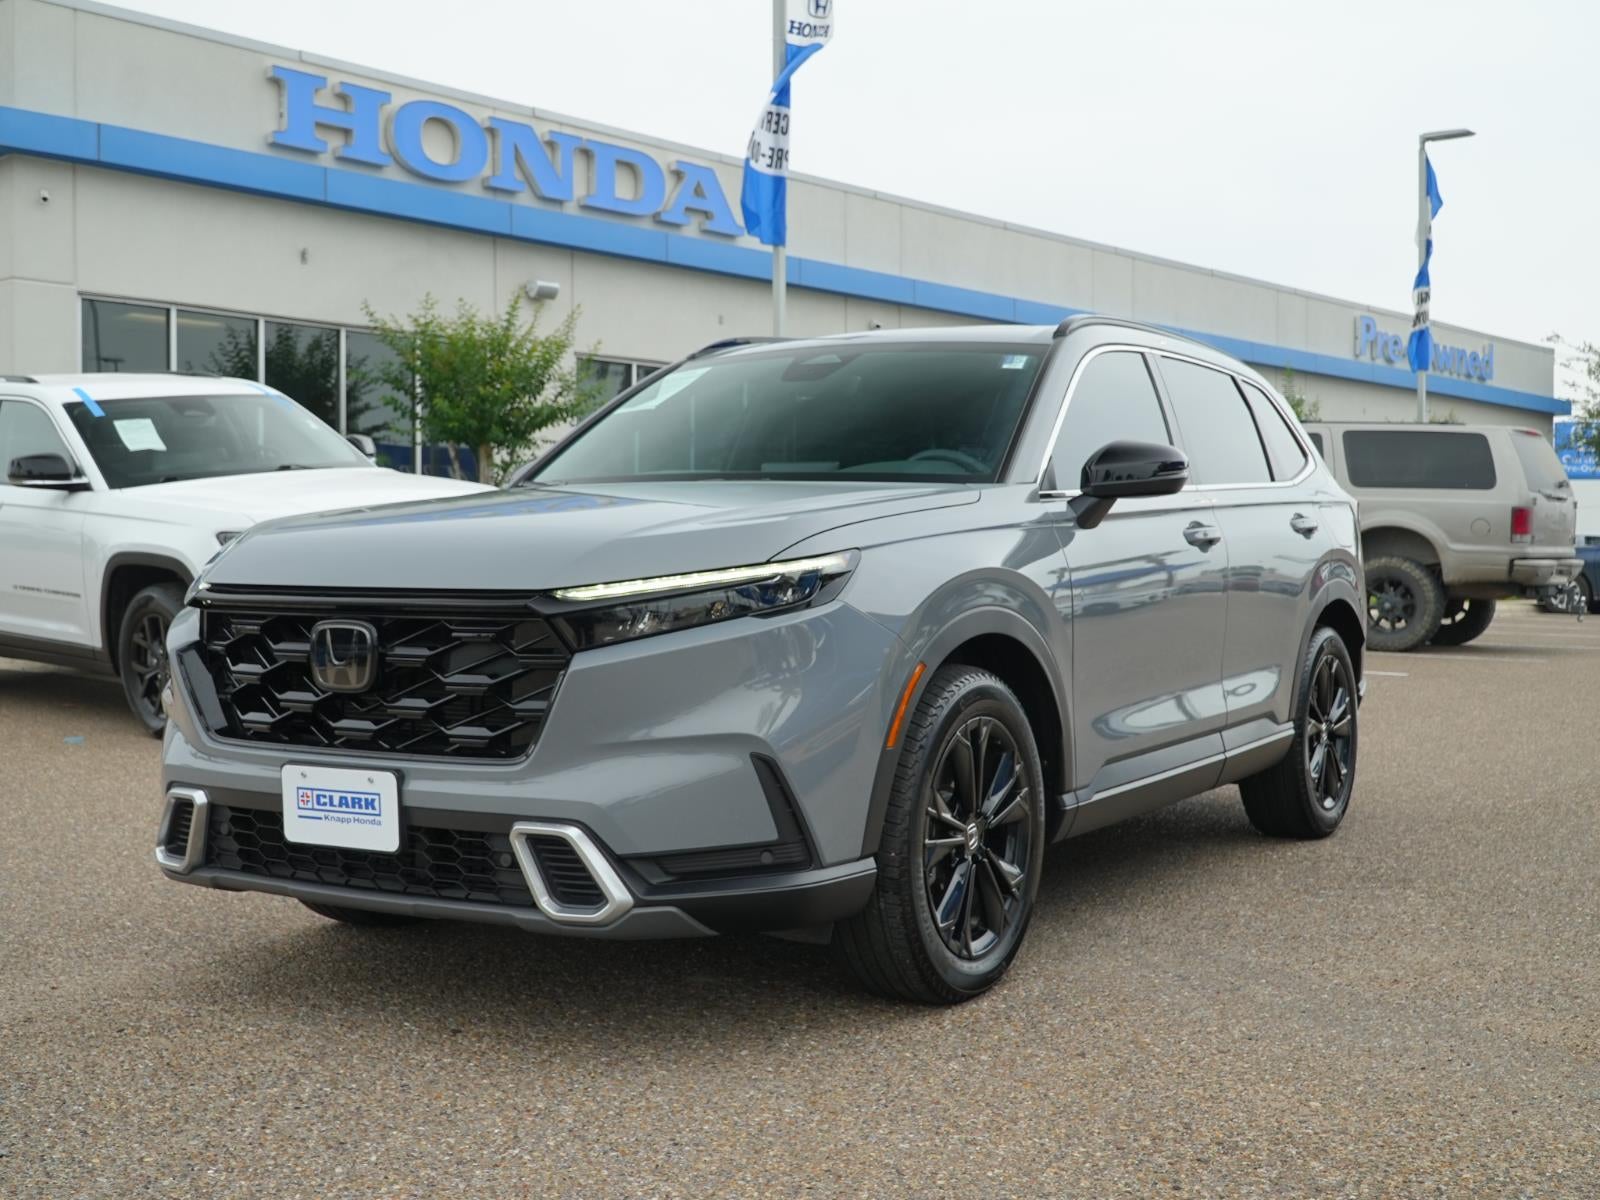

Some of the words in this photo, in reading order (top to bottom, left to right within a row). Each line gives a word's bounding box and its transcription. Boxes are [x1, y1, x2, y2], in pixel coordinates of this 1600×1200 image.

[267, 65, 746, 237] HONDA
[1355, 314, 1495, 382] Pre-wned
[315, 793, 377, 811] CLARK
[323, 813, 352, 825] Knapp
[353, 815, 382, 826] Honda
